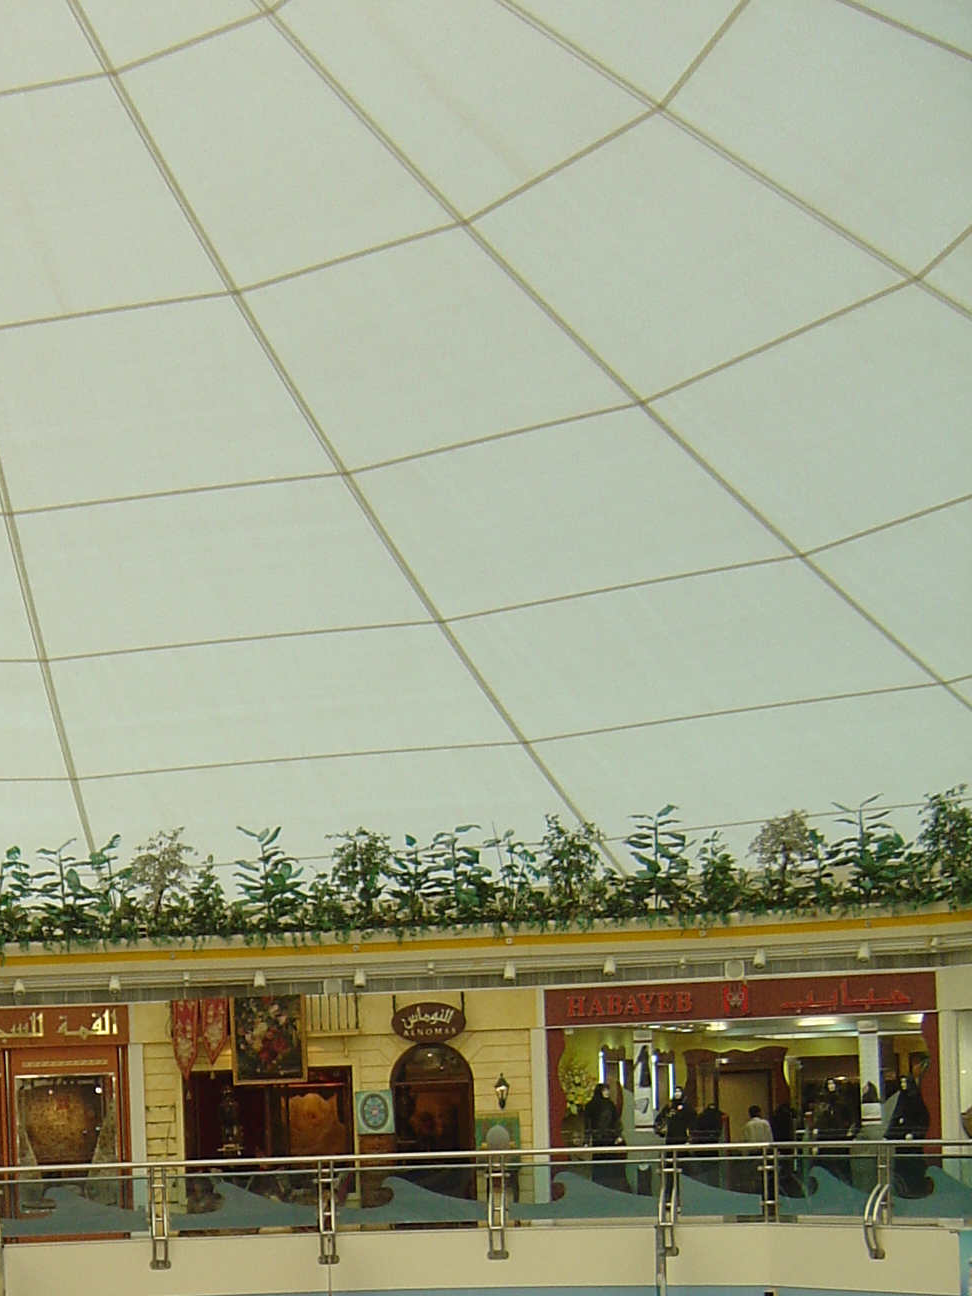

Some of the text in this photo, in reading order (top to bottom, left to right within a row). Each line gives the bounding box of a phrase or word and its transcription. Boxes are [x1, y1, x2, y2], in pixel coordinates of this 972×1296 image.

[566, 991, 693, 1018] HABAYEB
[58, 1008, 118, 1041] القمة
[403, 1027, 456, 1036] ALNOMAS
